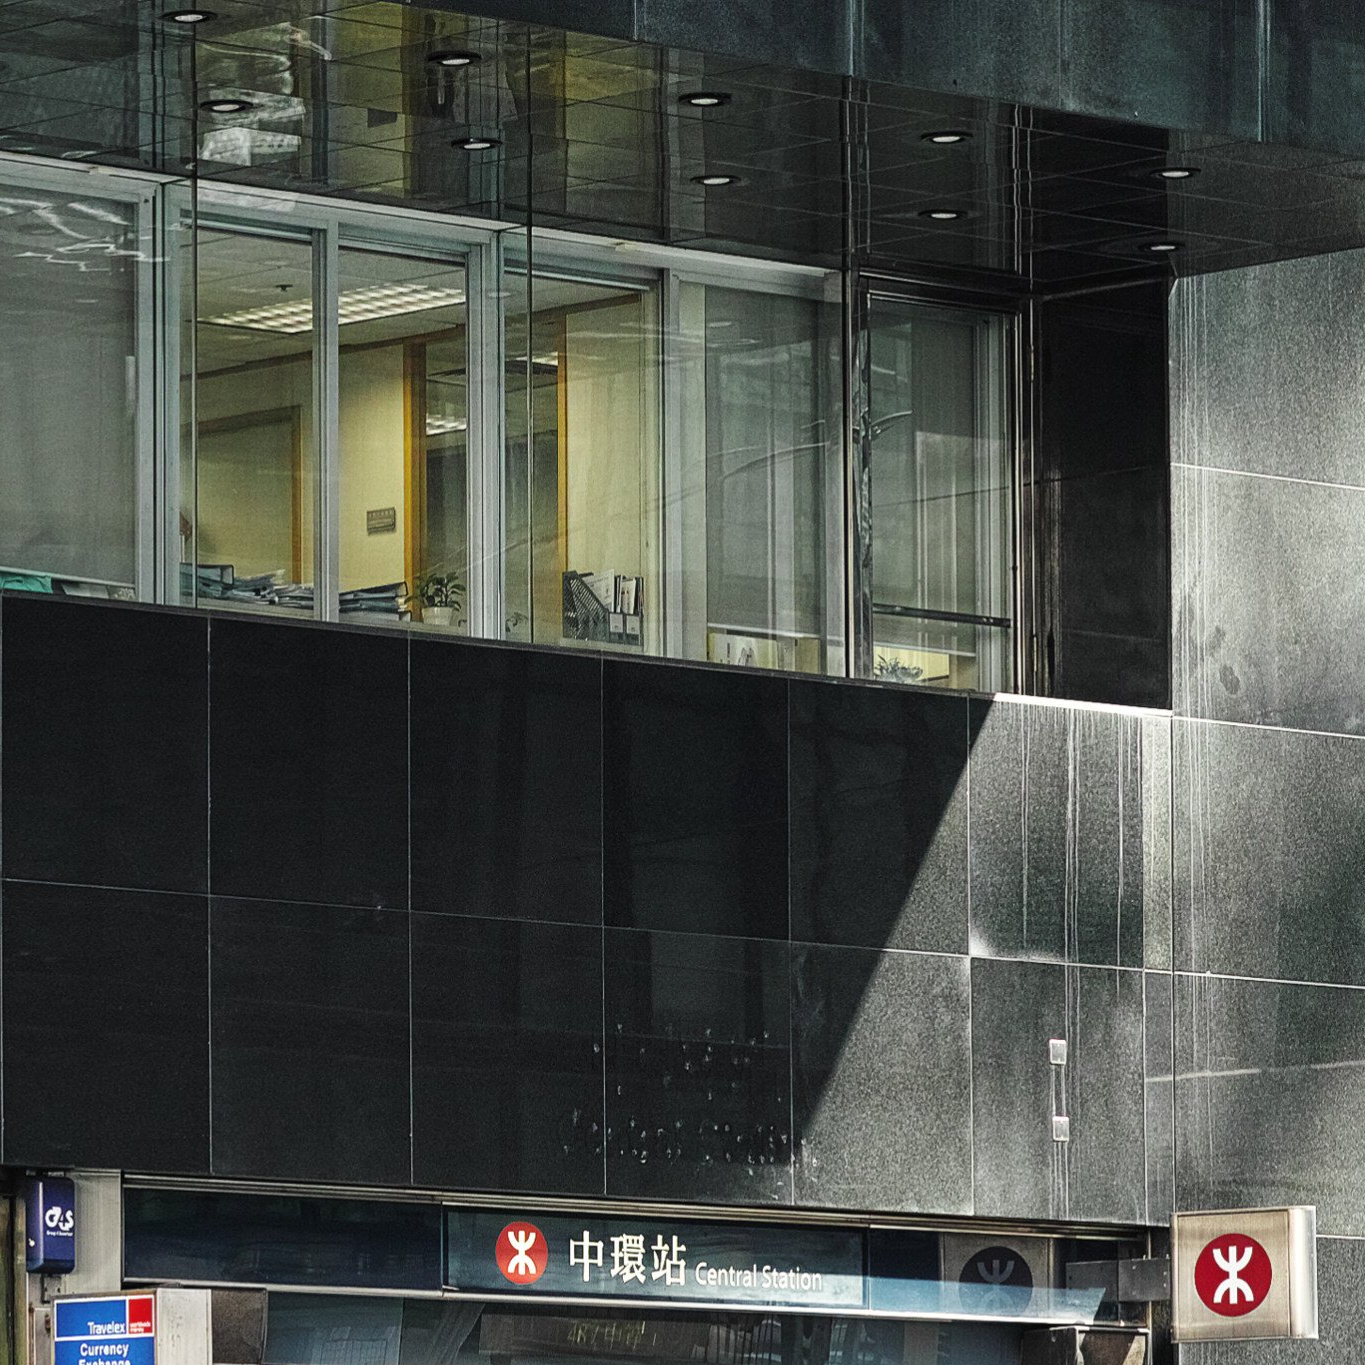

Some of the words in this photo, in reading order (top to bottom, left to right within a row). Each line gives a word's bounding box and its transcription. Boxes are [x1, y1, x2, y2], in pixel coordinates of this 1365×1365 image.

[570, 1229, 687, 1286] 中環站
[695, 1262, 756, 1289] Central
[762, 1266, 822, 1292] Station
[87, 1321, 126, 1335] Travelex
[80, 1343, 129, 1358] Currency
